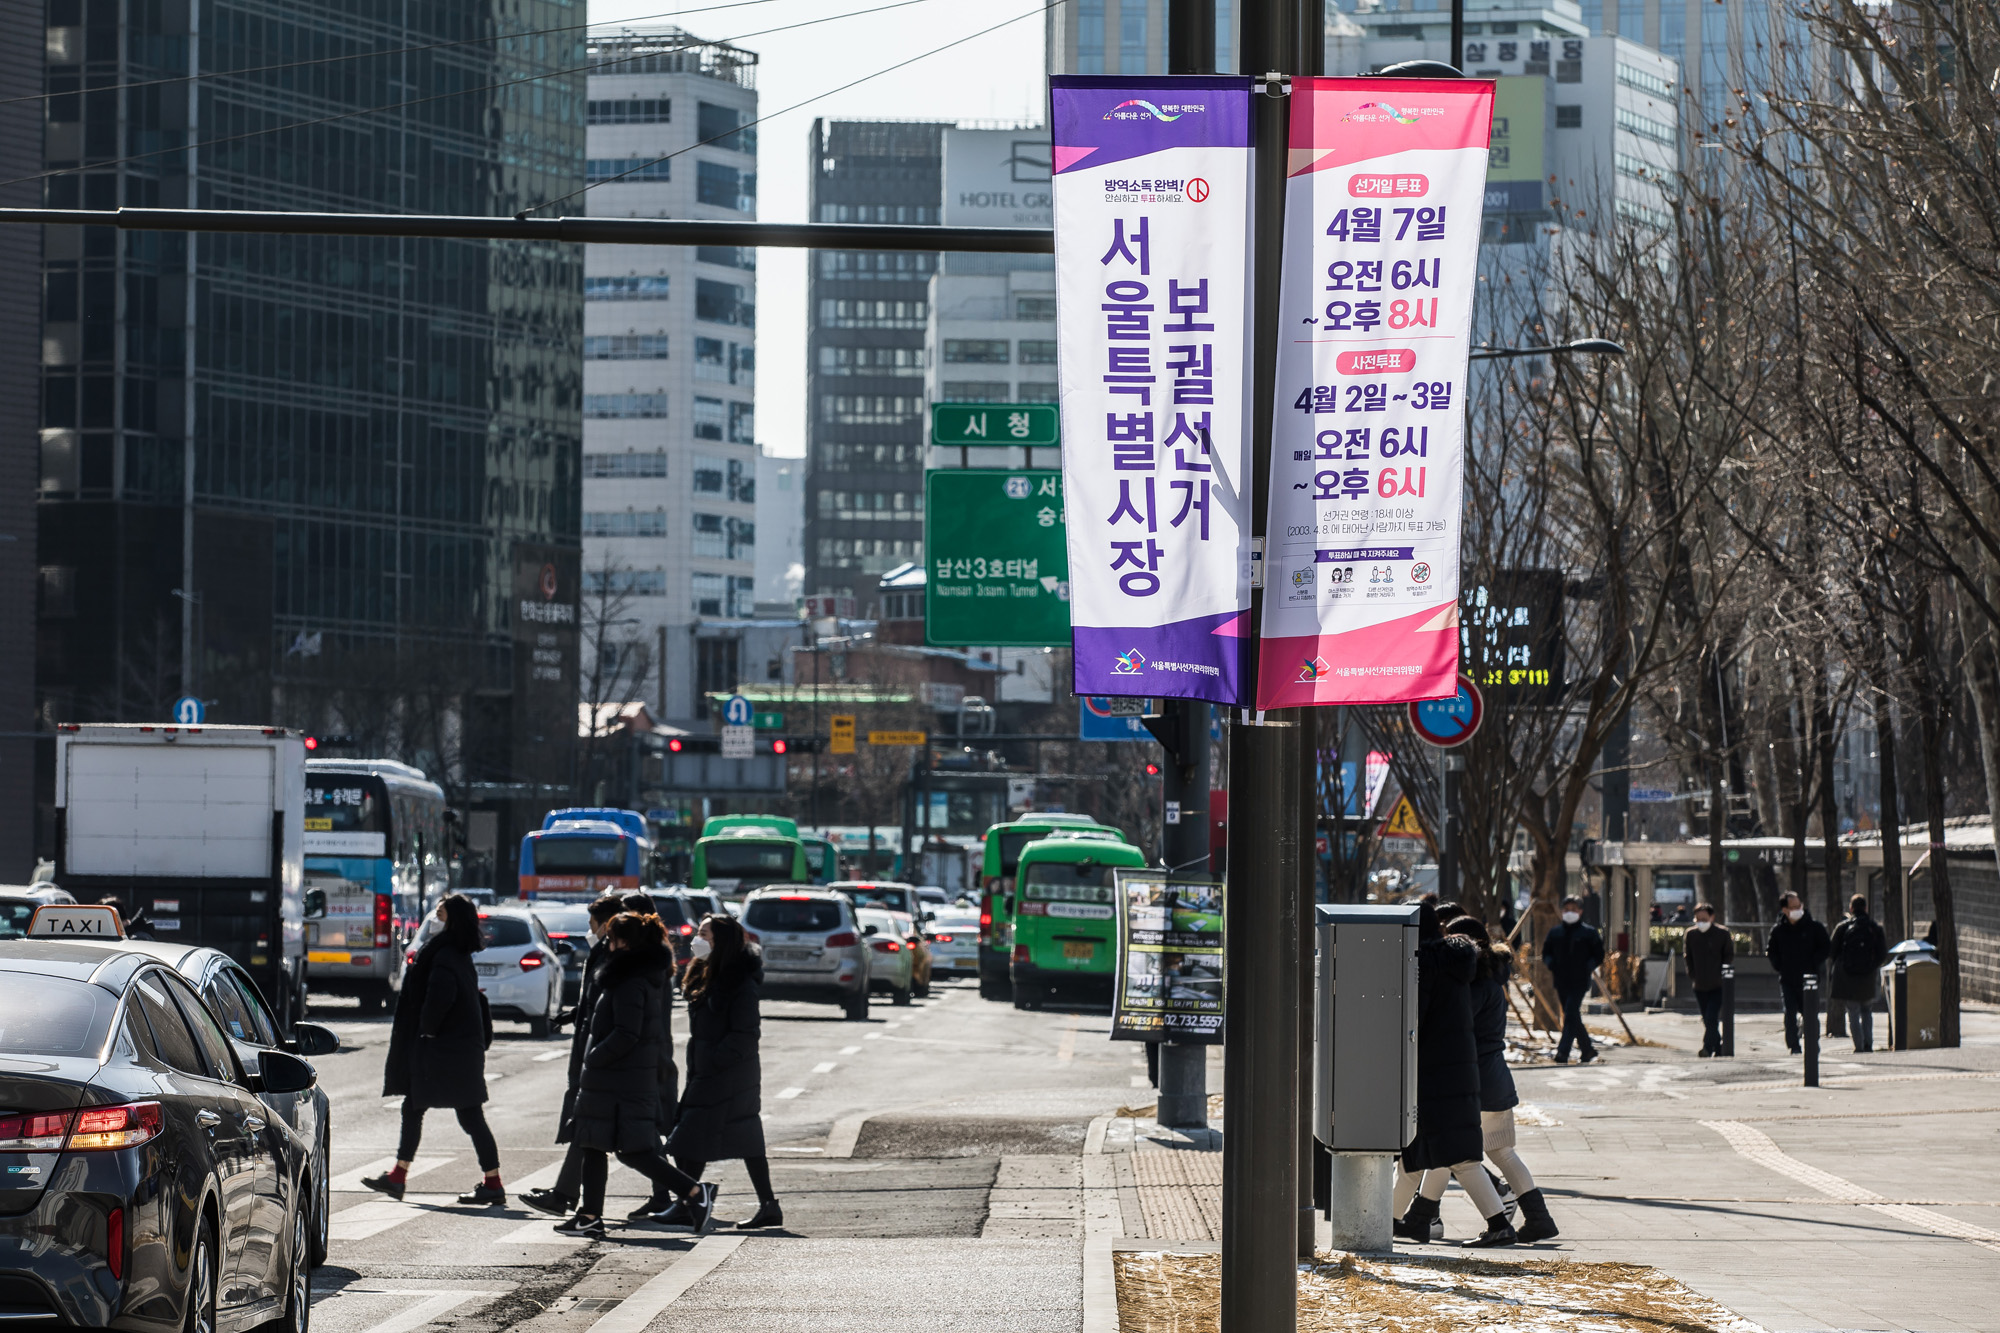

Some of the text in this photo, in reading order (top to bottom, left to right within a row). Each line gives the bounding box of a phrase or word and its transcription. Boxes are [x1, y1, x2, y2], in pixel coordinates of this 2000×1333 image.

[1114, 112, 1152, 120] 아름다운 선거
[1162, 104, 1205, 112] 행복한 대한민국
[1401, 107, 1445, 116] 행복한 대한민국
[1352, 114, 1390, 123] 아름다운 선거
[1104, 179, 1184, 192] 방역소독 완벽!
[1355, 178, 1422, 194] 선거일 투표
[960, 192, 1017, 208] HOTEL
[1104, 194, 1184, 203] 안심하고 투표하세요.
[1326, 206, 1446, 243] 4월 7일
[1326, 258, 1440, 292] 오전 6시
[1388, 297, 1438, 330] 8시
[1351, 354, 1401, 370] 사전투표
[1100, 216, 1165, 597] 서울특별시장
[1294, 385, 1337, 414] 4월
[1163, 278, 1214, 541] 보궐선거
[1293, 426, 1428, 462] 매일 오전 6시
[1037, 476, 1063, 497] 서
[1377, 467, 1426, 499] 6시
[1323, 510, 1349, 521] 선거권
[1351, 510, 1368, 521] 연령
[1396, 508, 1414, 519] 이상
[1408, 521, 1423, 532] 투표
[1328, 551, 1353, 559] 투표하실
[936, 557, 1038, 579] 남산3호터널
[936, 584, 972, 596] Namsan
[1010, 584, 1039, 597] Tunnel
[1150, 661, 1220, 677] 서울특별시선거관리위원회
[1336, 665, 1423, 677] 서울특별시선거관리위원회
[48, 918, 103, 934] TAXI
[1128, 998, 1147, 1006] HEALTH
[1119, 1016, 1152, 1026] FITNESS
